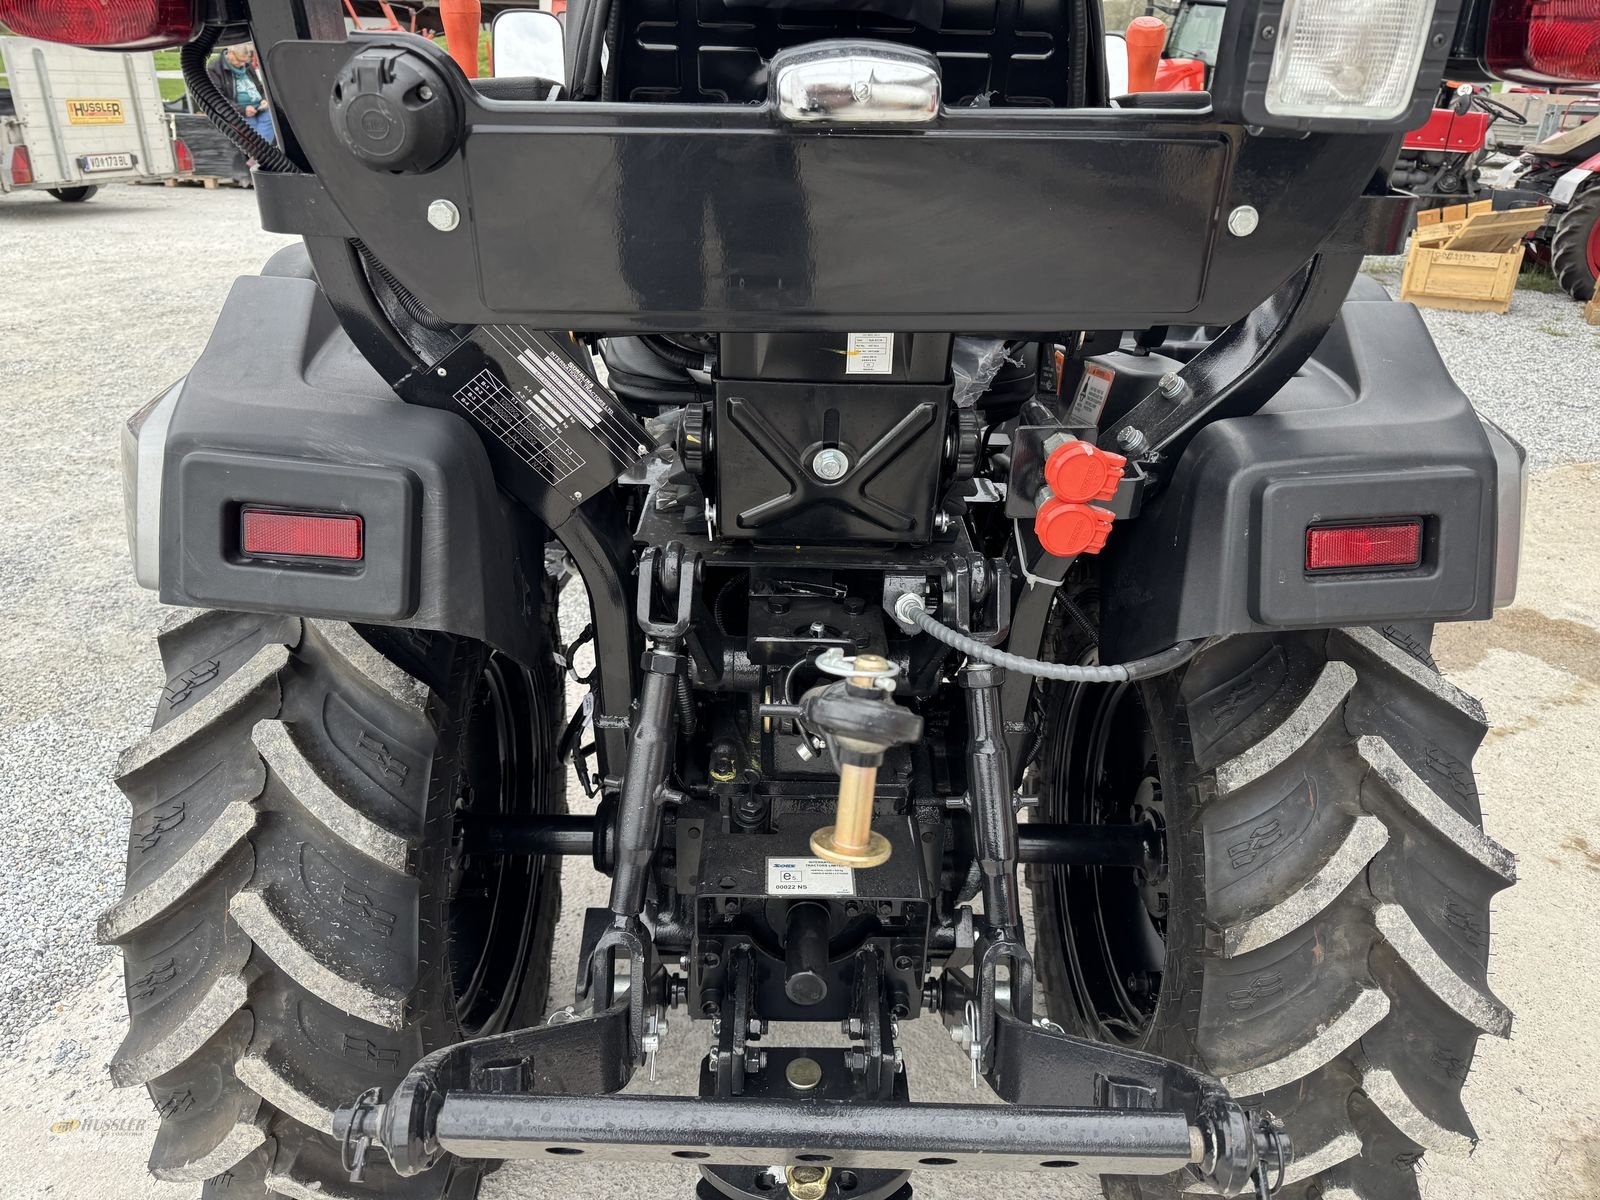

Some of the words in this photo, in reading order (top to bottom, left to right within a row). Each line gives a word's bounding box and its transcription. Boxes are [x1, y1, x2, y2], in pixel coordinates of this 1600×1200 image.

[73, 103, 121, 116] HUSSLER
[549, 350, 584, 385] INTERNATIONAL
[582, 383, 606, 406] TRACTORS
